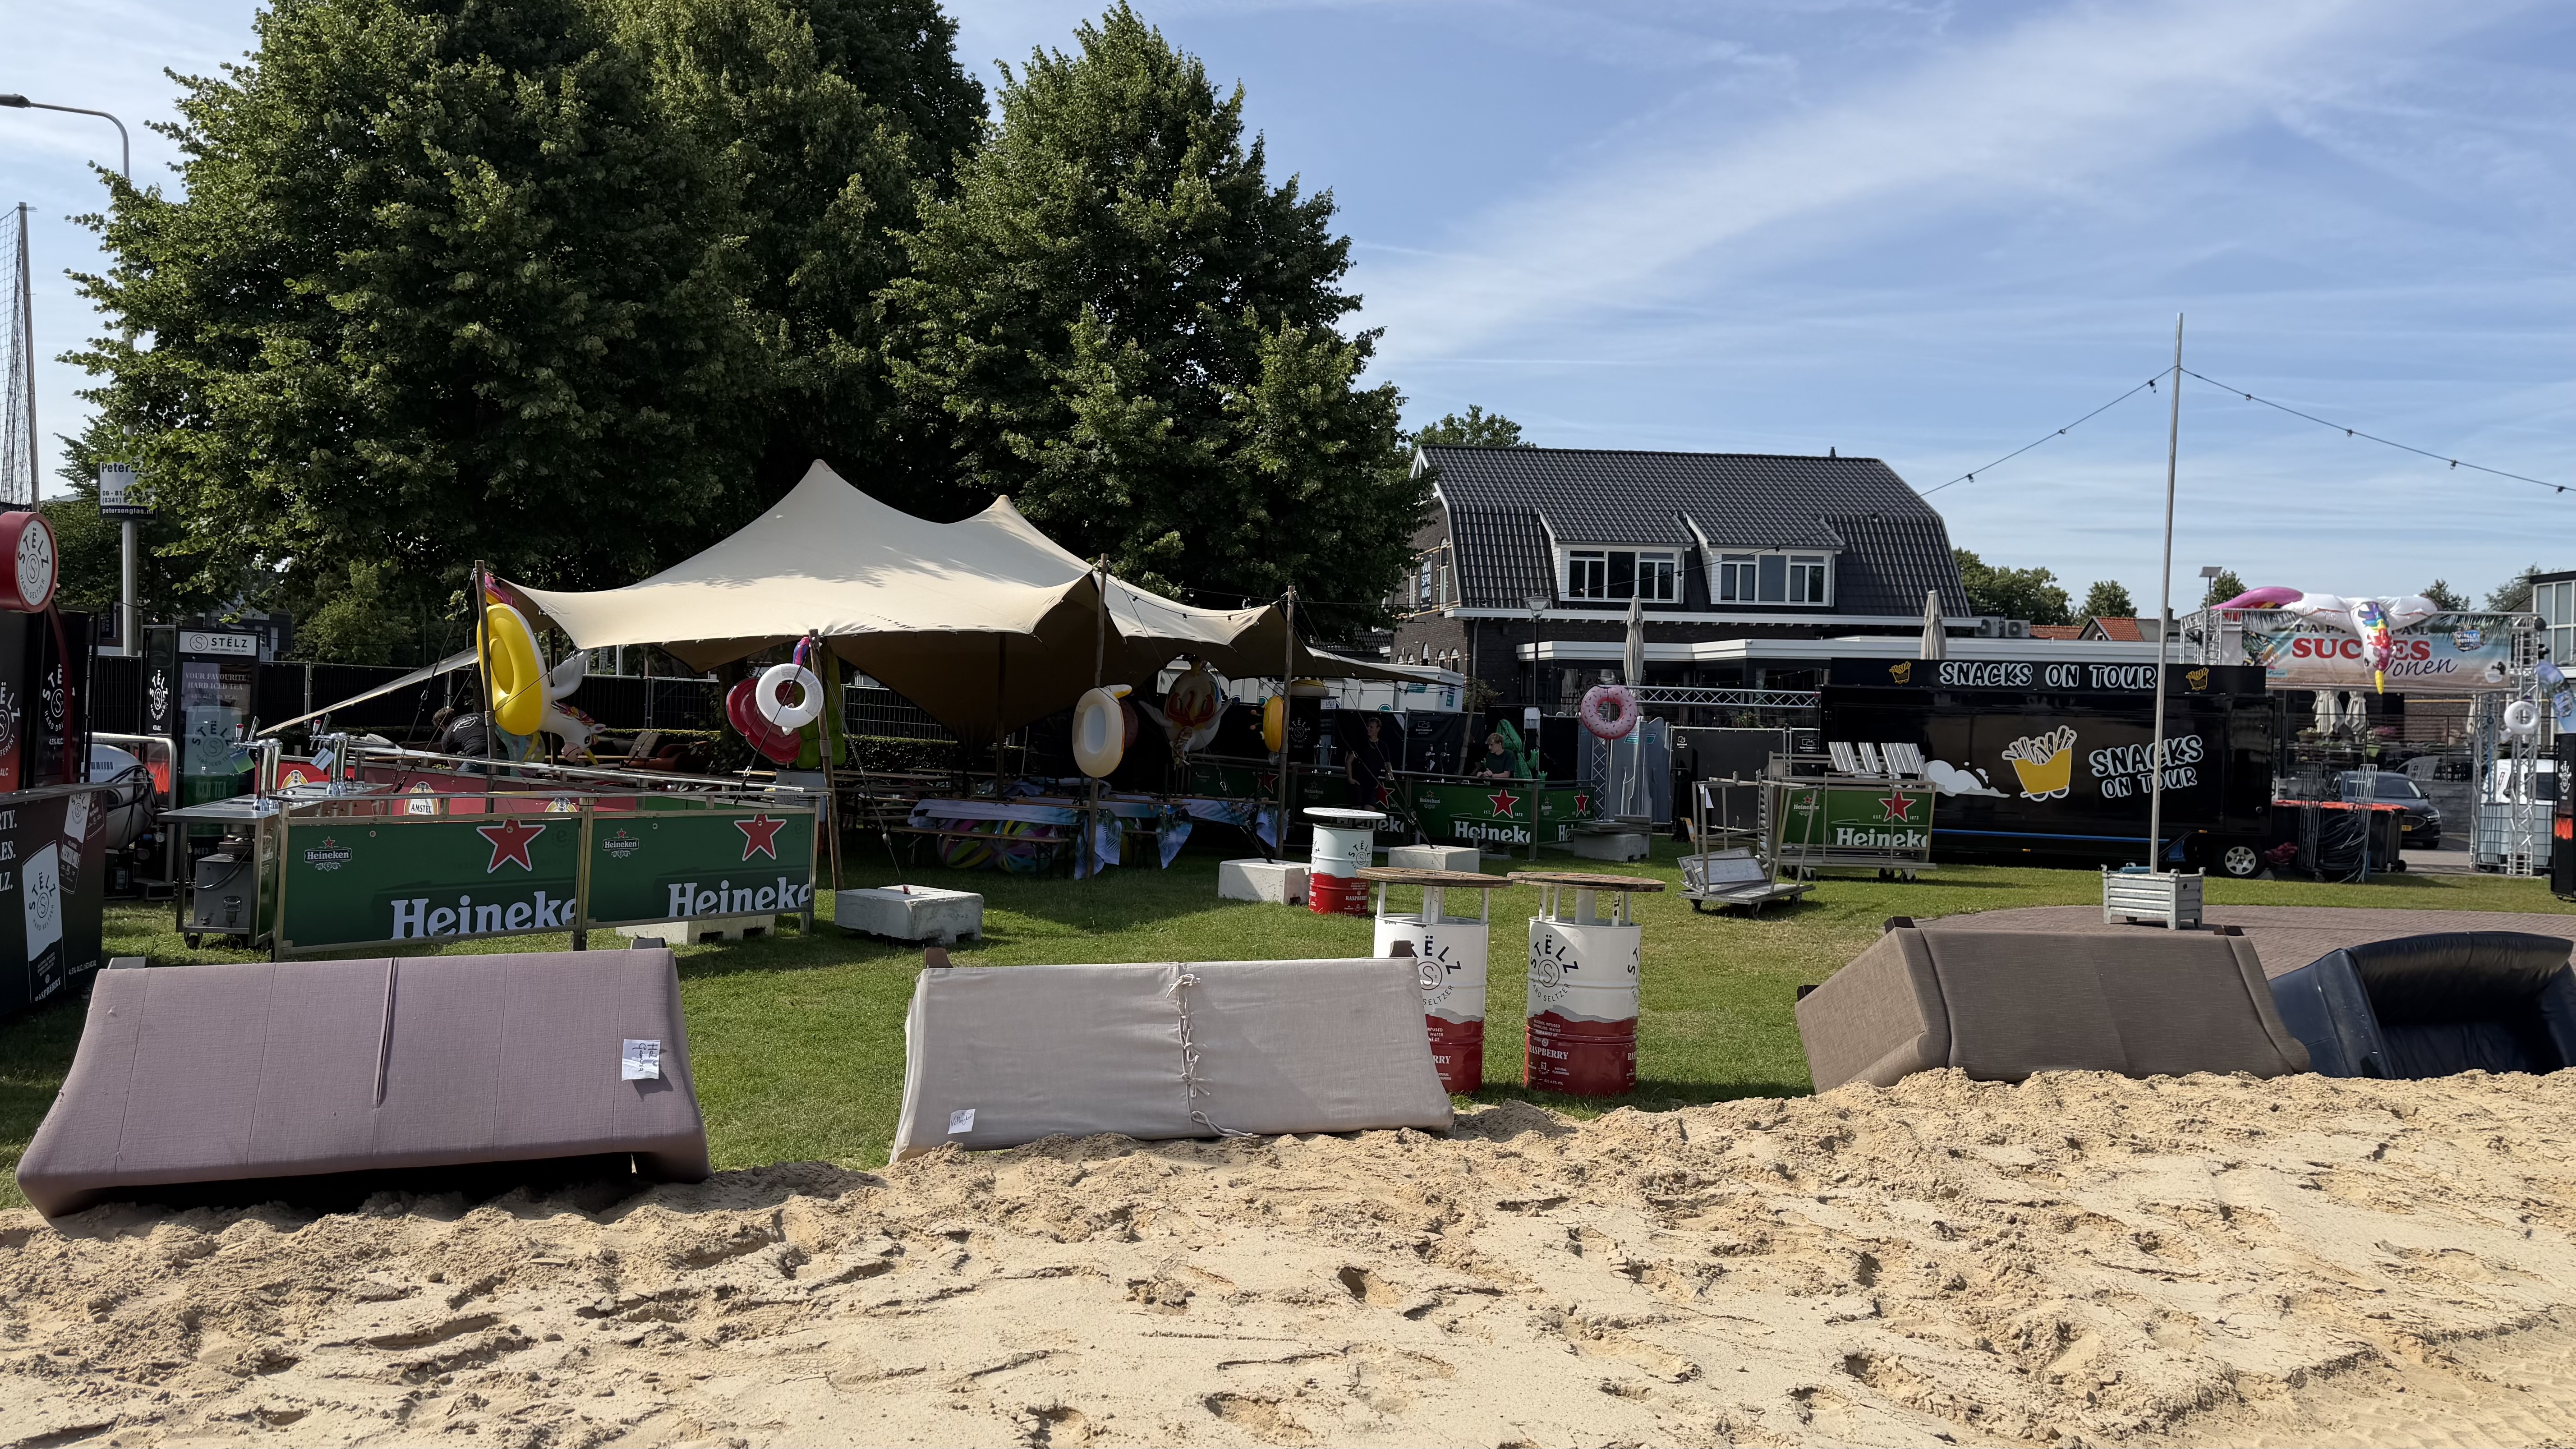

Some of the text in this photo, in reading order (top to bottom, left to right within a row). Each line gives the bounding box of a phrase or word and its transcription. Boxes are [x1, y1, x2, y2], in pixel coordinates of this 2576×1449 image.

[18, 527, 49, 568] STËLZ
[211, 636, 247, 648] STËLZ
[2292, 638, 2430, 661] SUCES
[207, 673, 247, 681] FAVOURITE
[1940, 662, 2157, 689] SNACKS ON TOUR
[55, 721, 64, 731] DRI
[192, 721, 235, 746] STËLZ
[1289, 718, 1310, 732] STËLZ
[2089, 735, 2204, 778] SNACKS
[2101, 767, 2198, 800] ON TOUR
[411, 804, 432, 814] AMSTEL
[307, 851, 350, 860] Heineken
[1348, 840, 1371, 857] STËLZ
[30, 872, 56, 910] STËLZ
[1411, 935, 1461, 975] ËLZ
[1531, 934, 1579, 973] STËLZ
[1628, 947, 1638, 975] ST
[1423, 985, 1454, 1005] SELTZER
[1544, 983, 1571, 1002] SELTZER
[1433, 1055, 1451, 1064] RRY
[1529, 1044, 1569, 1060] RASPBERRY
[1541, 1062, 1547, 1070] 63
